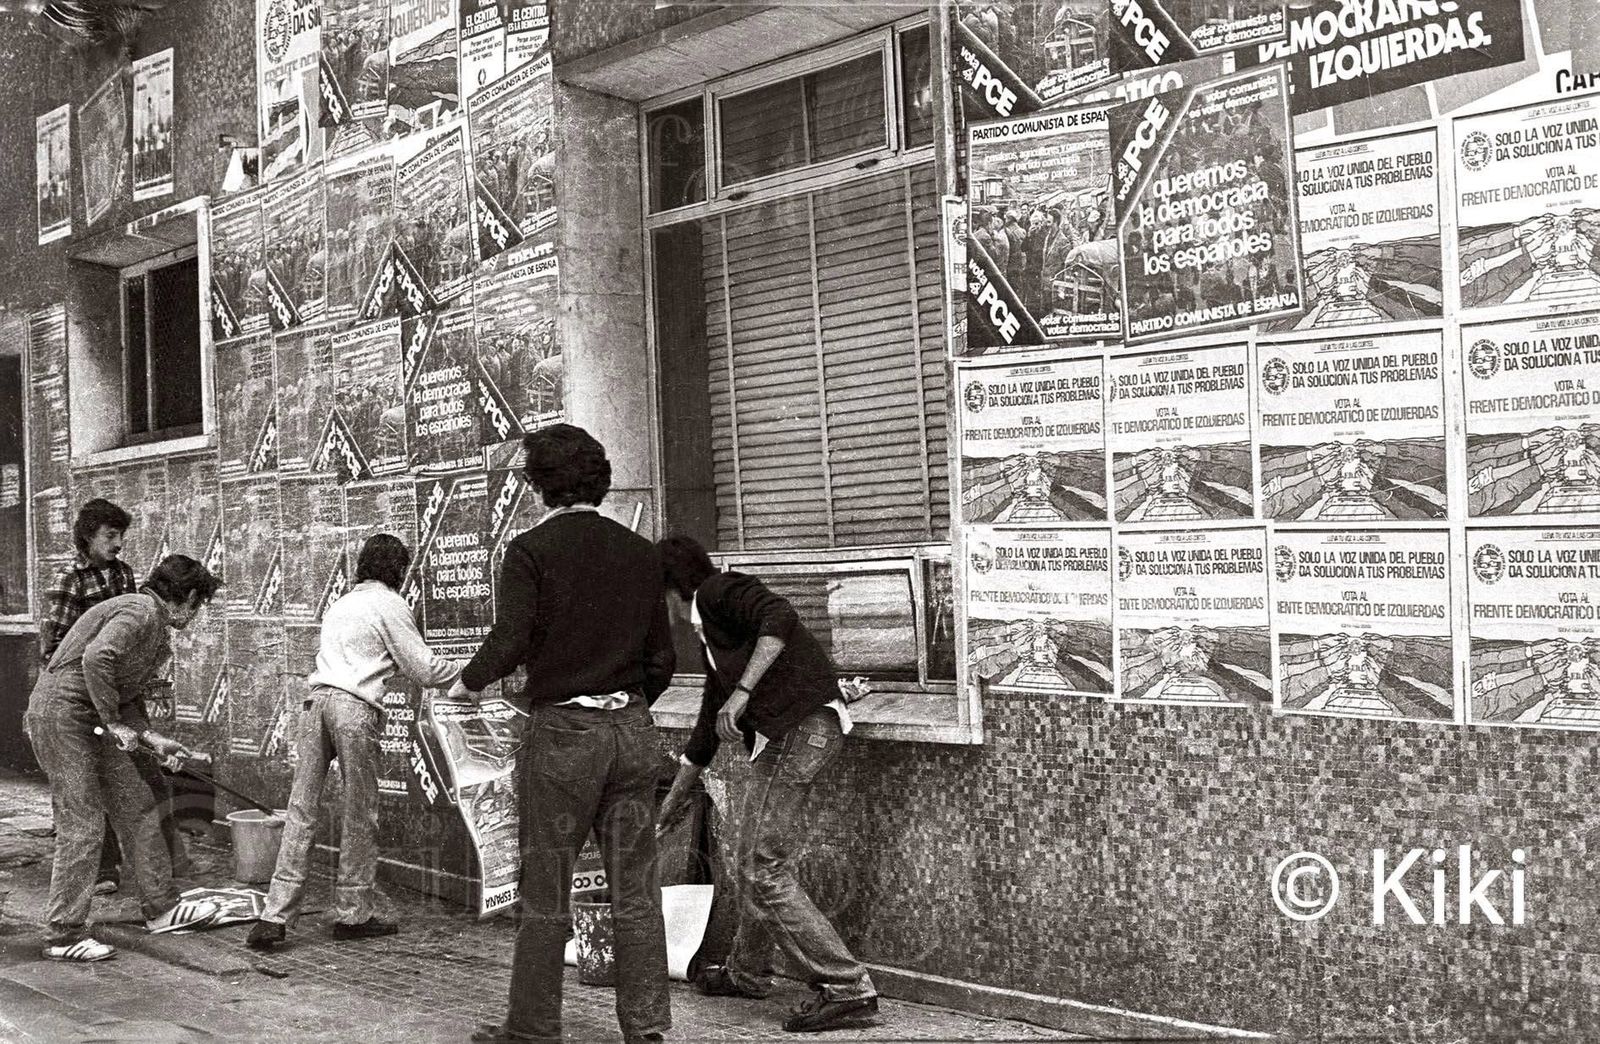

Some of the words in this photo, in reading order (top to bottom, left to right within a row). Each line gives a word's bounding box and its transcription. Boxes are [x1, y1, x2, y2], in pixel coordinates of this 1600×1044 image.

[1120, 1, 1170, 64] PCE
[1218, 15, 1267, 32] comunista
[1269, 12, 1282, 22] es
[1200, 35, 1223, 48] votar
[1225, 23, 1282, 43] democracia
[960, 46, 980, 70] vota
[1310, 11, 1492, 88] IZQUIERDAS.
[971, 64, 1018, 117] PCE
[1205, 89, 1227, 101] votar
[1229, 75, 1277, 96] comunista
[1202, 103, 1224, 115] votar
[1225, 88, 1278, 108] democracia
[972, 124, 1009, 141] PARTIDO
[1012, 116, 1064, 135] COMUNISTA
[1067, 113, 1078, 126] DE
[1123, 97, 1169, 172] PCE
[1117, 169, 1138, 201] vota
[1152, 159, 1247, 203] queremos
[1139, 203, 1154, 228] la
[1157, 180, 1268, 222] democracia
[483, 209, 510, 250] PCE
[1153, 222, 1194, 253] para
[1199, 209, 1254, 239] todos
[1143, 253, 1171, 276] los
[1174, 232, 1272, 270] españoles
[968, 258, 988, 286] vota
[977, 281, 1021, 344] PCE
[1062, 312, 1106, 323] comunista
[1131, 316, 1172, 334] PARTIDO
[1175, 306, 1237, 325] COMUNISTA
[1238, 302, 1252, 314] DE
[1254, 292, 1298, 312] ESPAÑA
[1047, 326, 1068, 335] votar
[1069, 322, 1119, 334] democracia
[1292, 361, 1314, 374] SOLO
[1317, 360, 1328, 373] LA
[1332, 358, 1350, 372] VOZ
[1352, 356, 1380, 370] UNIDA
[1383, 355, 1399, 368] DEL
[1402, 352, 1437, 367] PUEBLO
[419, 365, 462, 390] queremos
[1293, 376, 1305, 388] DA
[1307, 373, 1350, 387] SOLUCION
[1351, 373, 1358, 385] A
[1360, 371, 1378, 384] TUS
[1380, 367, 1438, 383] PROBLEMAS
[413, 388, 421, 404] la
[422, 378, 472, 401] democracia
[1334, 399, 1351, 409] VOTA
[1353, 398, 1361, 408] AL
[420, 405, 439, 422] para
[441, 399, 464, 415] todos
[484, 396, 511, 440] PCE
[1262, 413, 1296, 426] FRENTE
[1299, 409, 1364, 425] DEMOCRATICO
[1367, 408, 1378, 422] DE
[1381, 405, 1439, 421] IZQUIERDAS
[415, 420, 428, 437] los
[429, 414, 472, 436] españoles
[423, 481, 444, 528] PCE
[495, 470, 519, 521] PCE
[435, 532, 479, 553] queremos
[430, 550, 438, 566] la
[439, 548, 488, 566] democracia
[1299, 552, 1320, 564] SOLO
[1324, 552, 1336, 564] LA
[1339, 552, 1356, 564] VOZ
[1359, 552, 1386, 564] UNIDA
[1390, 552, 1406, 564] DEL
[1408, 552, 1444, 564] PUEBLO
[436, 568, 456, 586] para
[457, 565, 482, 580] todos
[1299, 566, 1312, 577] DA
[1314, 566, 1356, 578] SOLUCION
[1358, 566, 1365, 578] A
[1366, 566, 1385, 578] TUS
[1387, 566, 1445, 579] PROBLEMAS
[432, 584, 445, 600] los
[446, 581, 490, 602] españoles
[1341, 591, 1357, 601] VOTA
[1359, 591, 1368, 601] AL
[1305, 602, 1371, 616] DEMOCRATICO
[1374, 603, 1386, 617] DE
[1388, 603, 1445, 619] IZQUIERDAS
[414, 762, 439, 805] PCE
